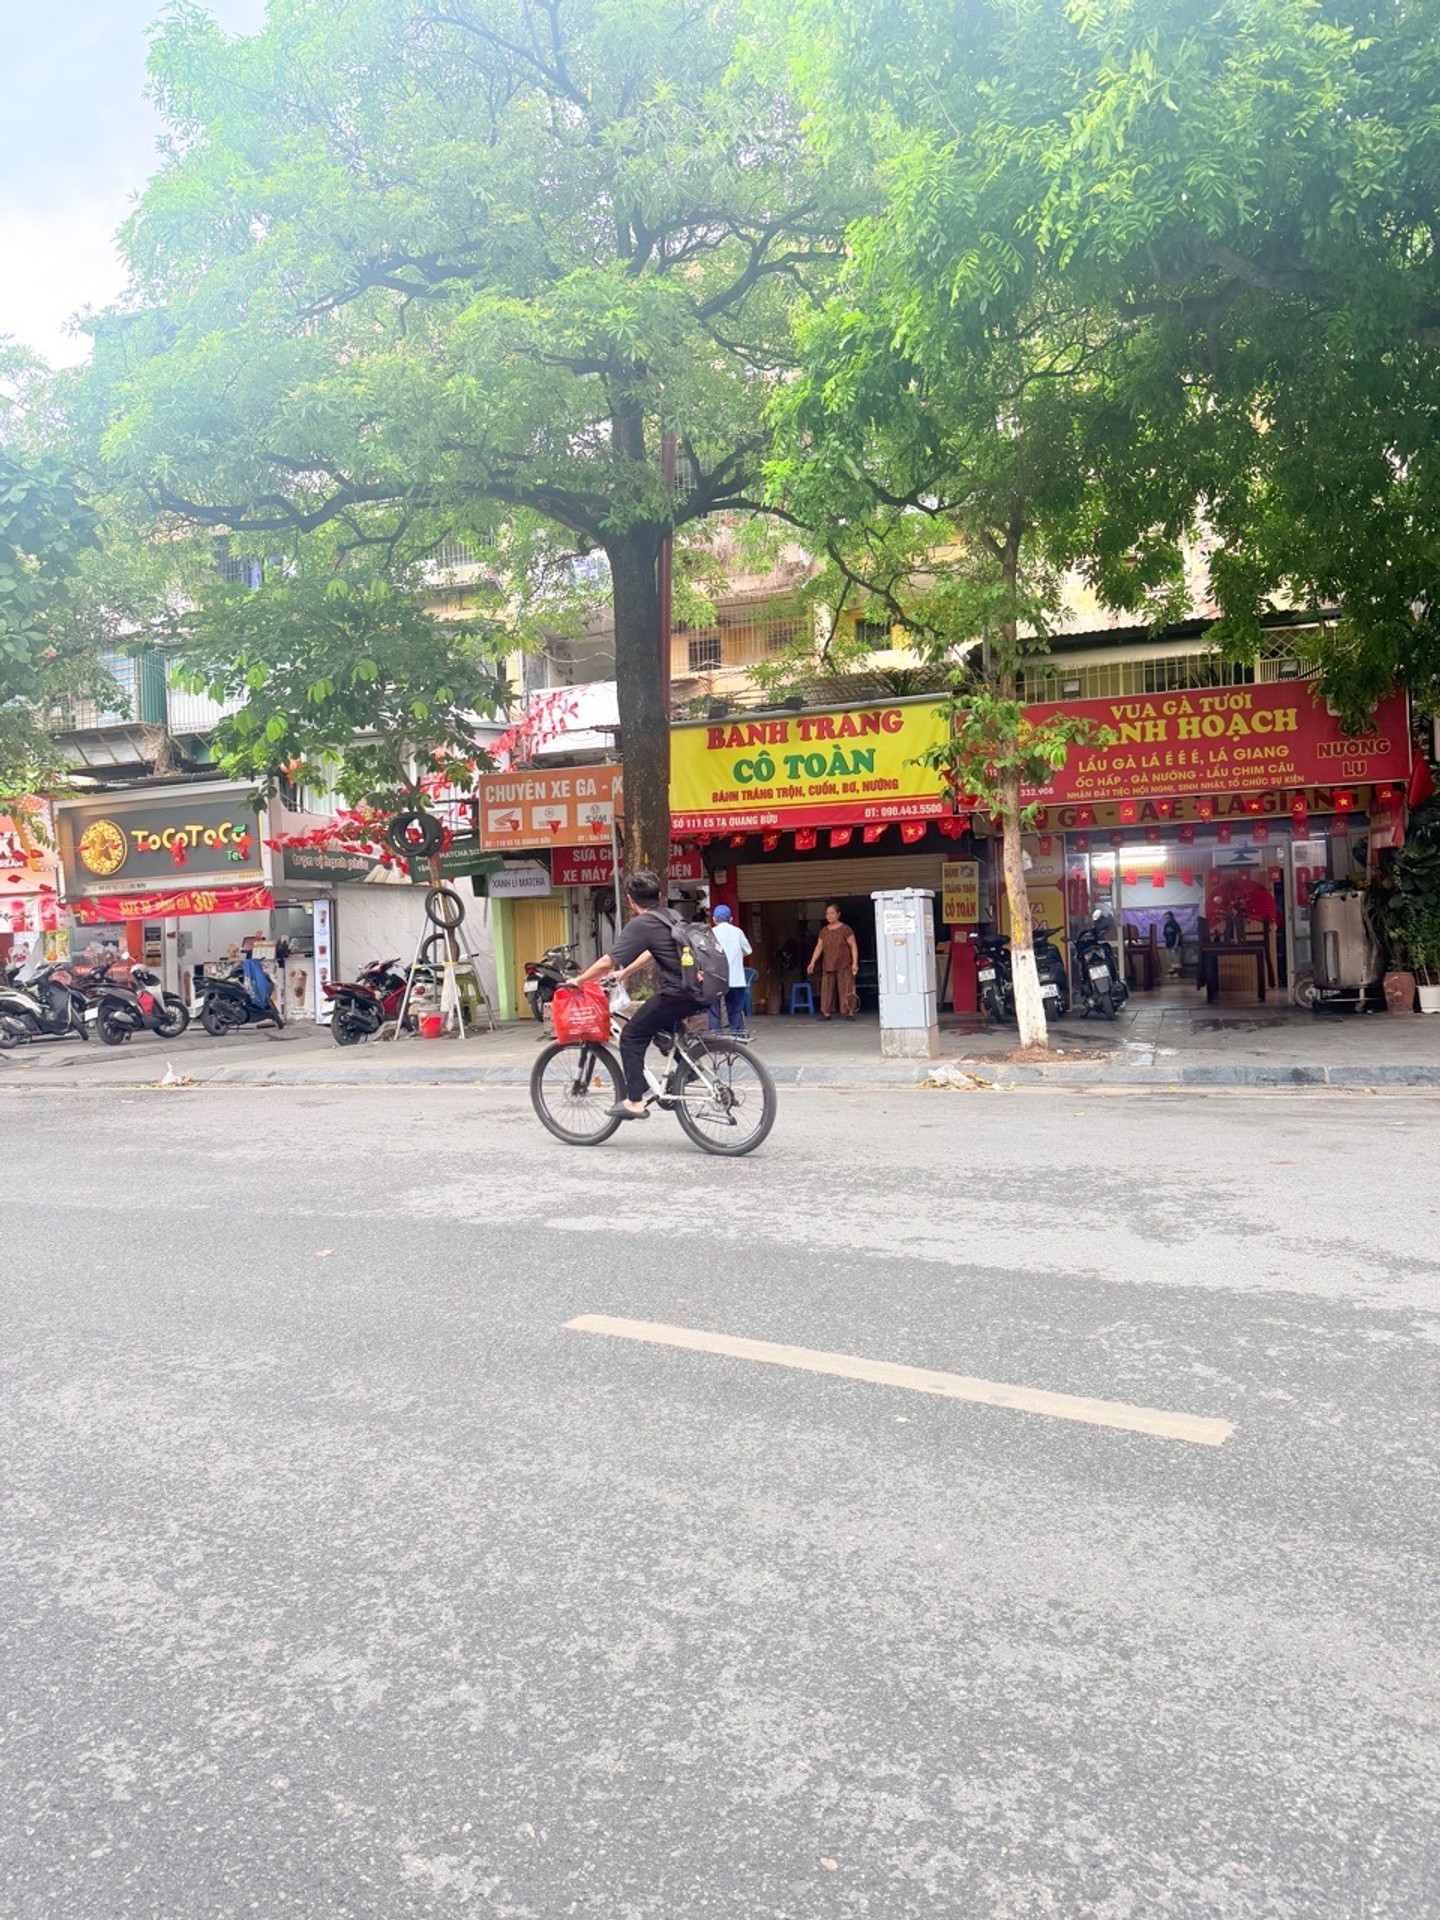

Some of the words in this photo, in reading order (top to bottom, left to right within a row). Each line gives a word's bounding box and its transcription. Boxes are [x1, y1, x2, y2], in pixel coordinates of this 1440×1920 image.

[1110, 702, 1157, 720] VUA
[1162, 696, 1194, 716] GÀ
[1199, 692, 1253, 713] TƯƠI
[706, 719, 790, 750] BÁNH
[796, 707, 905, 743] TRÁNG
[1098, 718, 1169, 753] ẠNH
[1177, 708, 1299, 742] HOẠCH
[732, 750, 777, 784] CÔ
[782, 742, 877, 781] TOÀN
[1078, 754, 1107, 773] LẨU
[1112, 752, 1137, 771] GÀ
[1141, 750, 1160, 768] LÁ
[1165, 750, 1174, 766] É
[1178, 749, 1187, 765] É
[1209, 744, 1228, 763] LÁ
[1233, 744, 1290, 761] GIANG
[1342, 760, 1368, 778] LU
[1066, 790, 1092, 801] NHẬN
[1112, 786, 1131, 799] TIỆC
[1132, 785, 1149, 798] HỘI
[1178, 782, 1199, 793] SINH
[1241, 775, 1269, 788] CHỨC
[1284, 773, 1305, 786] KIỆN
[1075, 773, 1094, 789] ỐC
[1097, 773, 1122, 787] HẤP
[1131, 771, 1149, 785] GÀ
[1152, 768, 1197, 782] NƯỚNG
[1206, 765, 1229, 778] LẨU
[1232, 765, 1265, 777] CHIM
[1268, 763, 1295, 775] CÂU
[485, 778, 547, 803] CHUYÊN
[550, 780, 571, 799] XE
[575, 777, 597, 797] GA
[712, 788, 739, 804] BÁNH
[741, 785, 774, 802] TRÁNG
[672, 815, 685, 830] SỐ
[686, 817, 701, 829] 111
[703, 817, 714, 828] E5
[716, 816, 727, 828] TẠ
[728, 813, 759, 828] QUANG
[880, 803, 943, 819] 090.443.5500
[492, 878, 511, 889] XANH
[519, 877, 546, 887] MATCHA
[562, 869, 578, 883] XE
[581, 866, 607, 882] MÁY
